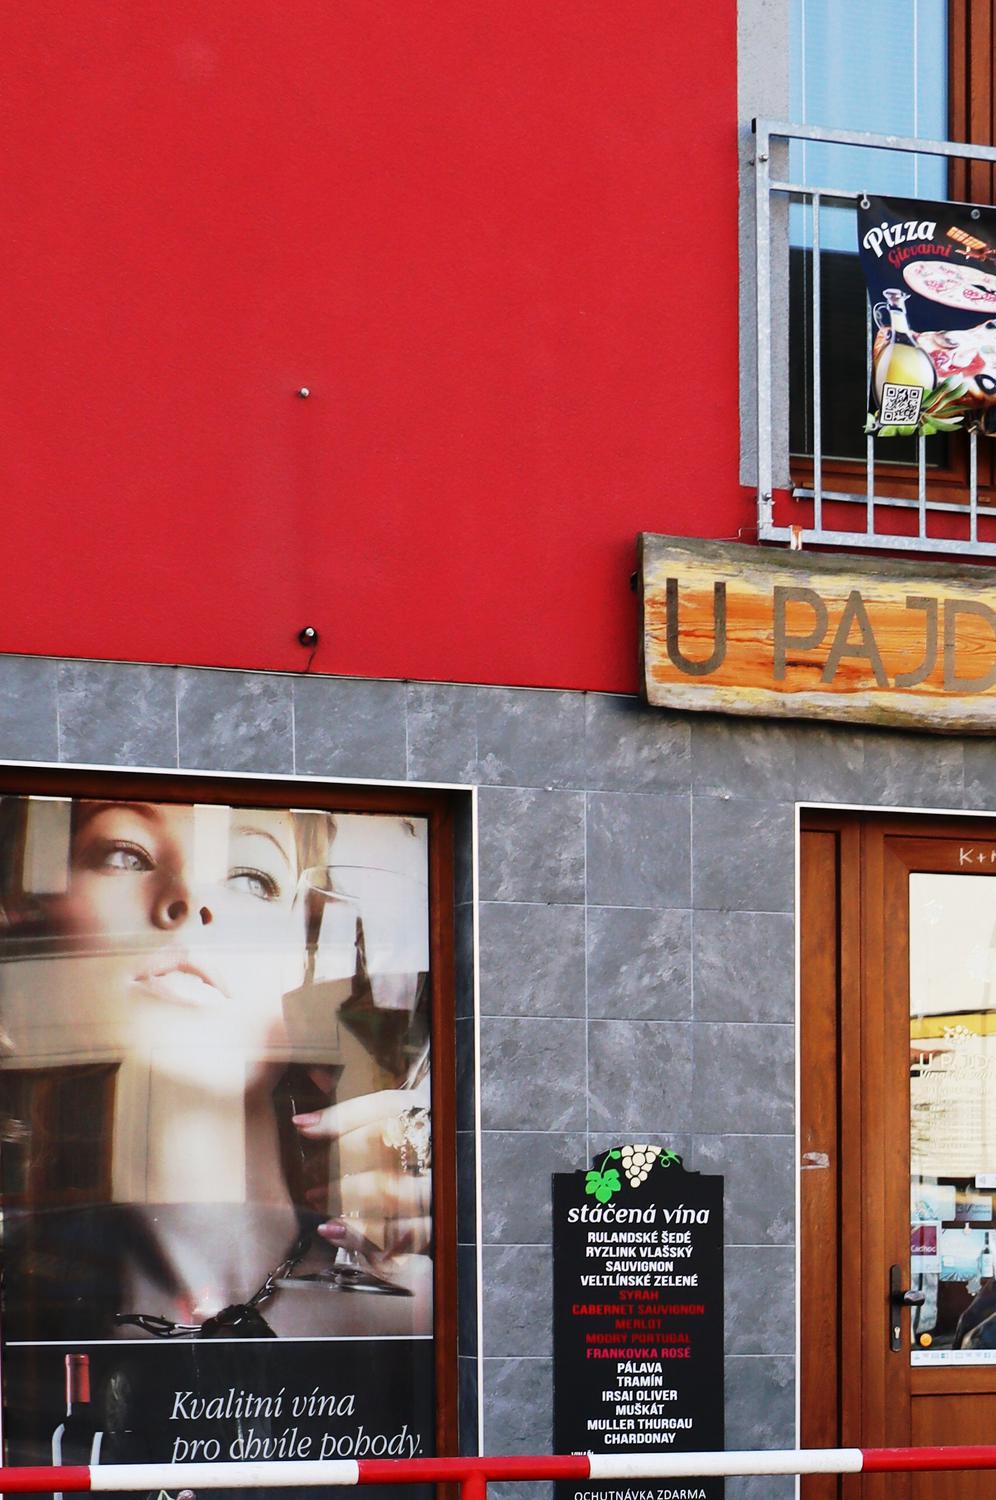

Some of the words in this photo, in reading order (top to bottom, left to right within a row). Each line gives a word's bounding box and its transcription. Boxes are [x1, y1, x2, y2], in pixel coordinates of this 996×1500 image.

[863, 221, 937, 258] Pizza
[888, 243, 953, 269] Giovanni
[666, 578, 726, 676] U
[567, 1203, 656, 1225] stáčená
[663, 1204, 710, 1225] vína
[587, 1231, 659, 1244] RULANDSKÉ
[661, 1230, 692, 1244] ŠEDÉ
[585, 1246, 637, 1258] RYZLINK
[639, 1244, 694, 1258] VLAŠSKÝ
[605, 1261, 674, 1272] SAUVIGNON
[580, 1273, 651, 1287] VELTLÍNSKÉ
[653, 1273, 699, 1287] ZELENÉ
[618, 1290, 660, 1301] SYRAH
[572, 1304, 634, 1316] CABERNET
[637, 1304, 705, 1316] SAUVIGNON
[615, 1318, 662, 1330] MERLOT
[586, 1348, 658, 1359] FRANKOVKA
[661, 1346, 691, 1359] ROSÉ
[617, 1361, 663, 1373] PÁLAVA
[616, 1374, 663, 1387] TRAMÍN
[602, 1390, 633, 1402] IRSAI
[636, 1390, 678, 1401] OLIVER
[169, 1386, 287, 1420] Kvalitní
[292, 1386, 356, 1418] vína
[615, 1403, 665, 1416] MUŠKÁT
[587, 1419, 635, 1431] MULLER
[637, 1418, 693, 1430] THURGAU
[171, 1435, 220, 1464] pro
[229, 1426, 312, 1461] chvíle
[319, 1424, 424, 1461] pohody.
[604, 1433, 676, 1445] CHARDONAY
[657, 1488, 707, 1500] ZDARMA
